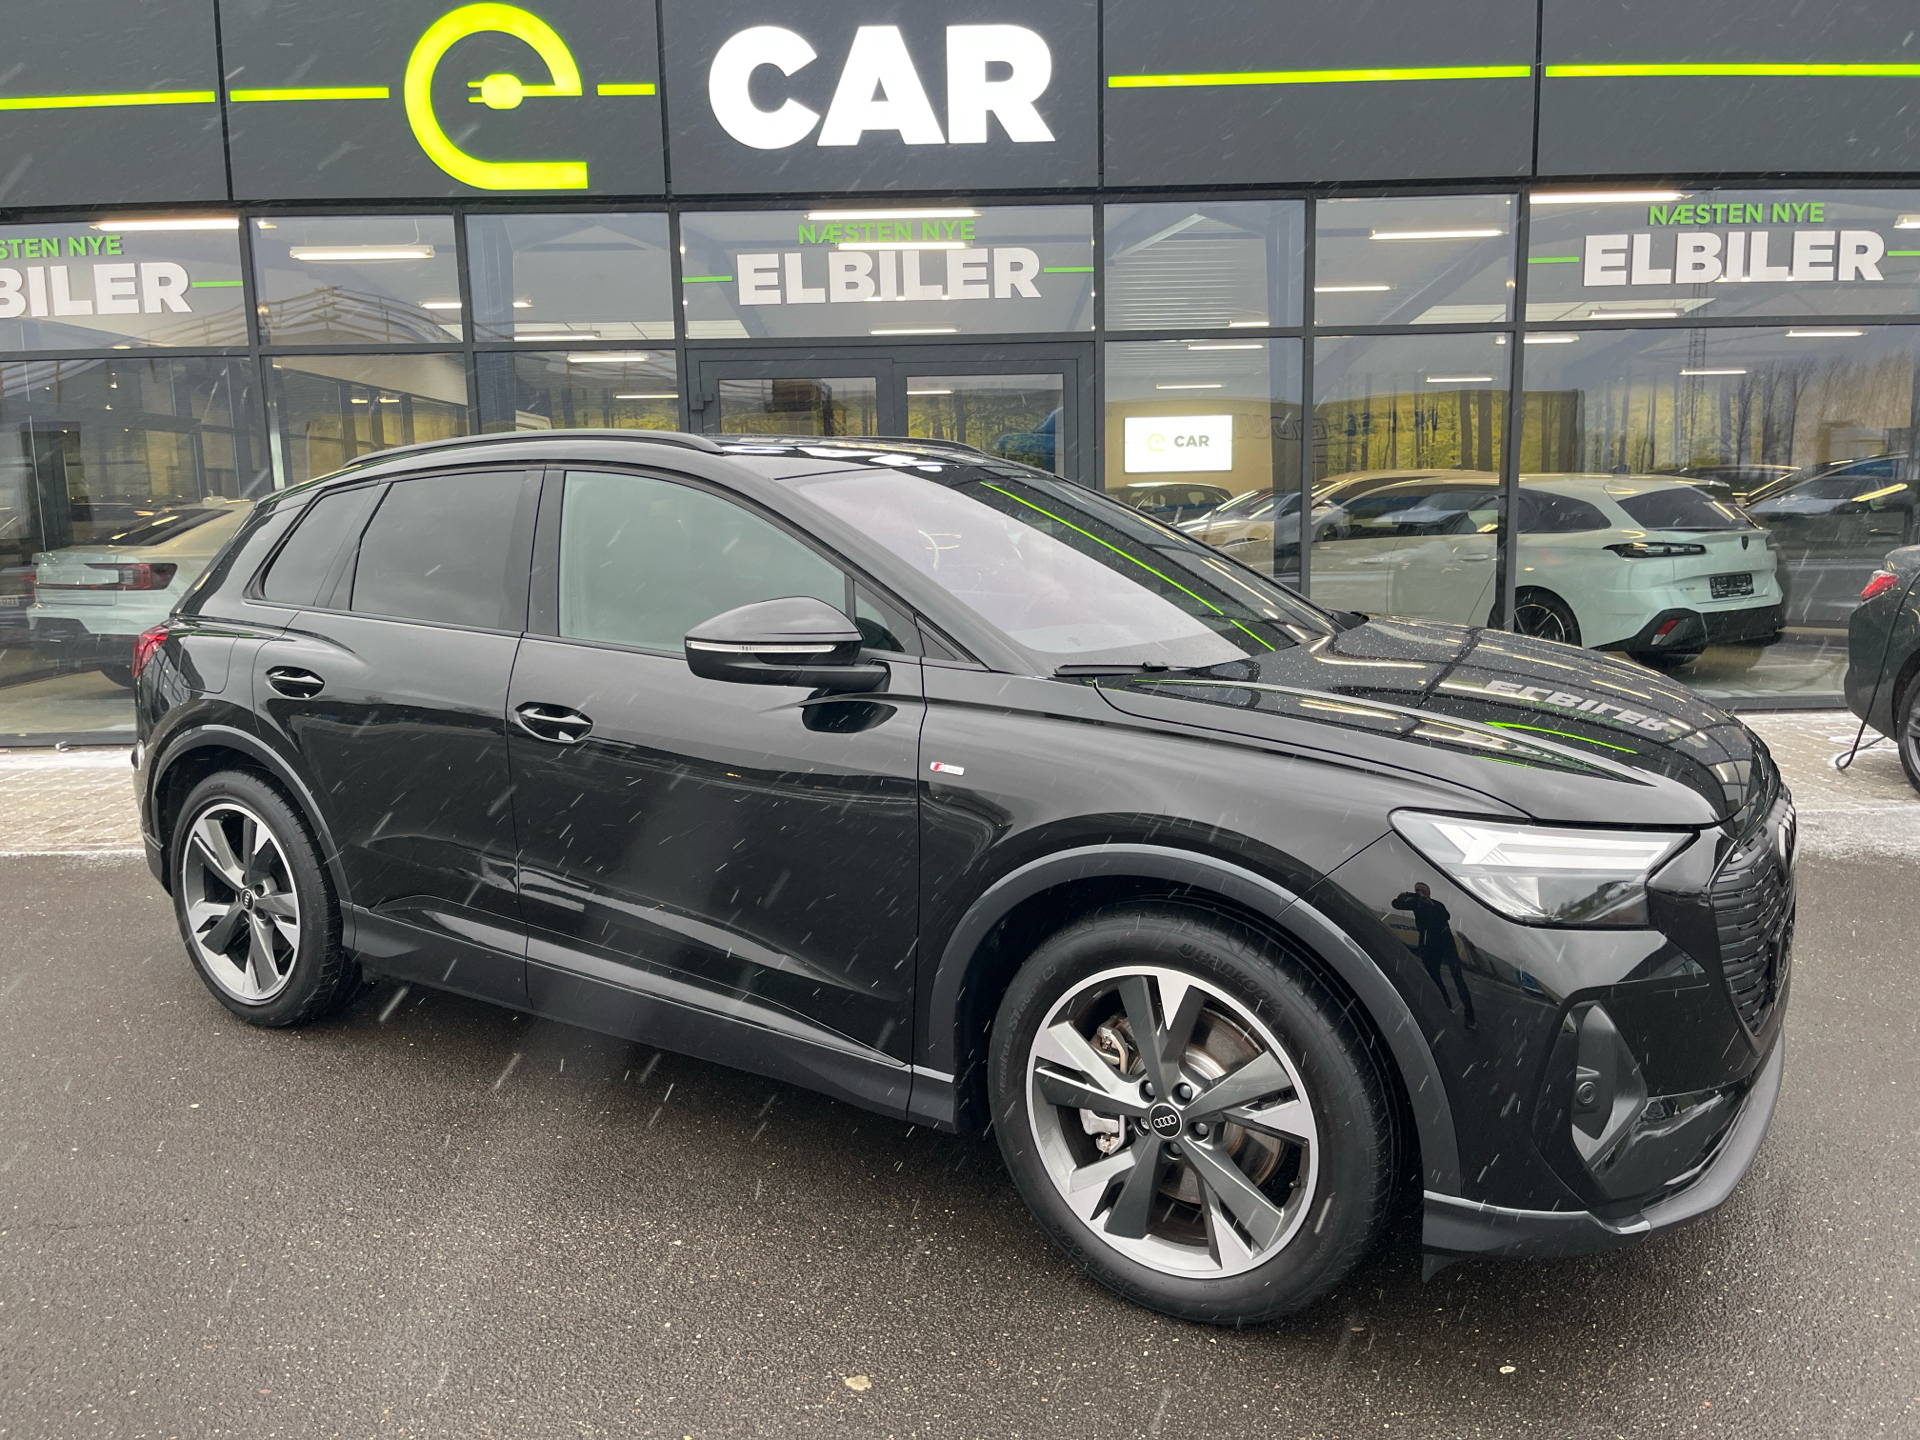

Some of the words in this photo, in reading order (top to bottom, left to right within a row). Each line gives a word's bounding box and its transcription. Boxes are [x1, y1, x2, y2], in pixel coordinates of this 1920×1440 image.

[708, 24, 1056, 149] CAR
[1650, 203, 1762, 225] NÆSTEN
[1772, 202, 1825, 223] NYE
[798, 221, 911, 244] NÆSTEN
[922, 219, 976, 241] NYE
[68, 234, 123, 255] NYE
[1583, 230, 1885, 286] ELBILER
[737, 247, 1041, 306] ELBILER
[1174, 435, 1210, 448] CAR
